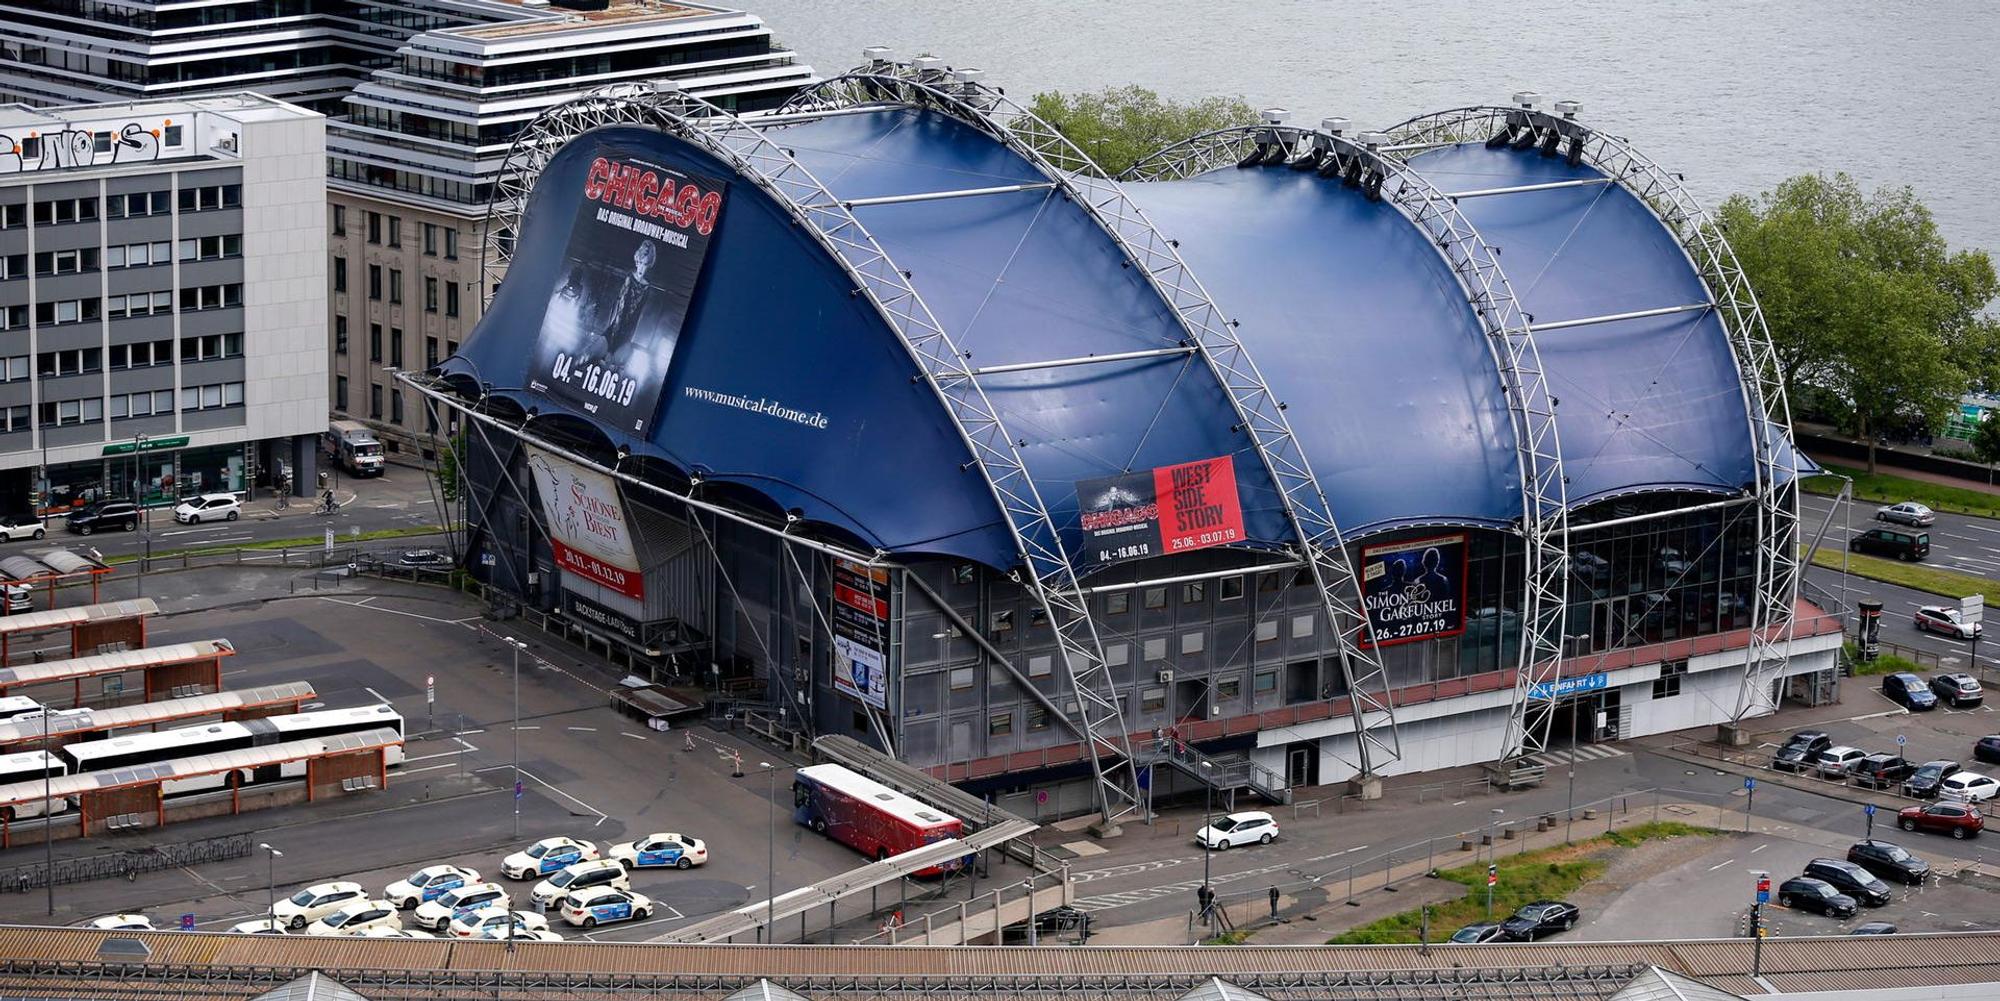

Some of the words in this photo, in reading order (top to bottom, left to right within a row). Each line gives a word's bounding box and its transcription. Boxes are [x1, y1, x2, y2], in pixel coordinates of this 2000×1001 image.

[585, 157, 722, 236] CHICAGO
[596, 207, 609, 223] DAS
[608, 211, 634, 231] ORIGINAL
[632, 218, 689, 250] BROADWAY-MUSICAL
[685, 386, 828, 429] www.musical-dome.de
[1171, 464, 1211, 489] WEST
[1174, 487, 1206, 511] SIDE
[584, 511, 617, 542] BIEST
[1081, 503, 1159, 531] CHICAGO
[1176, 504, 1223, 533] STORY
[1366, 592, 1410, 611] SIMON
[1380, 599, 1457, 622] GARFUNKEL
[1422, 613, 1442, 621] STORY
